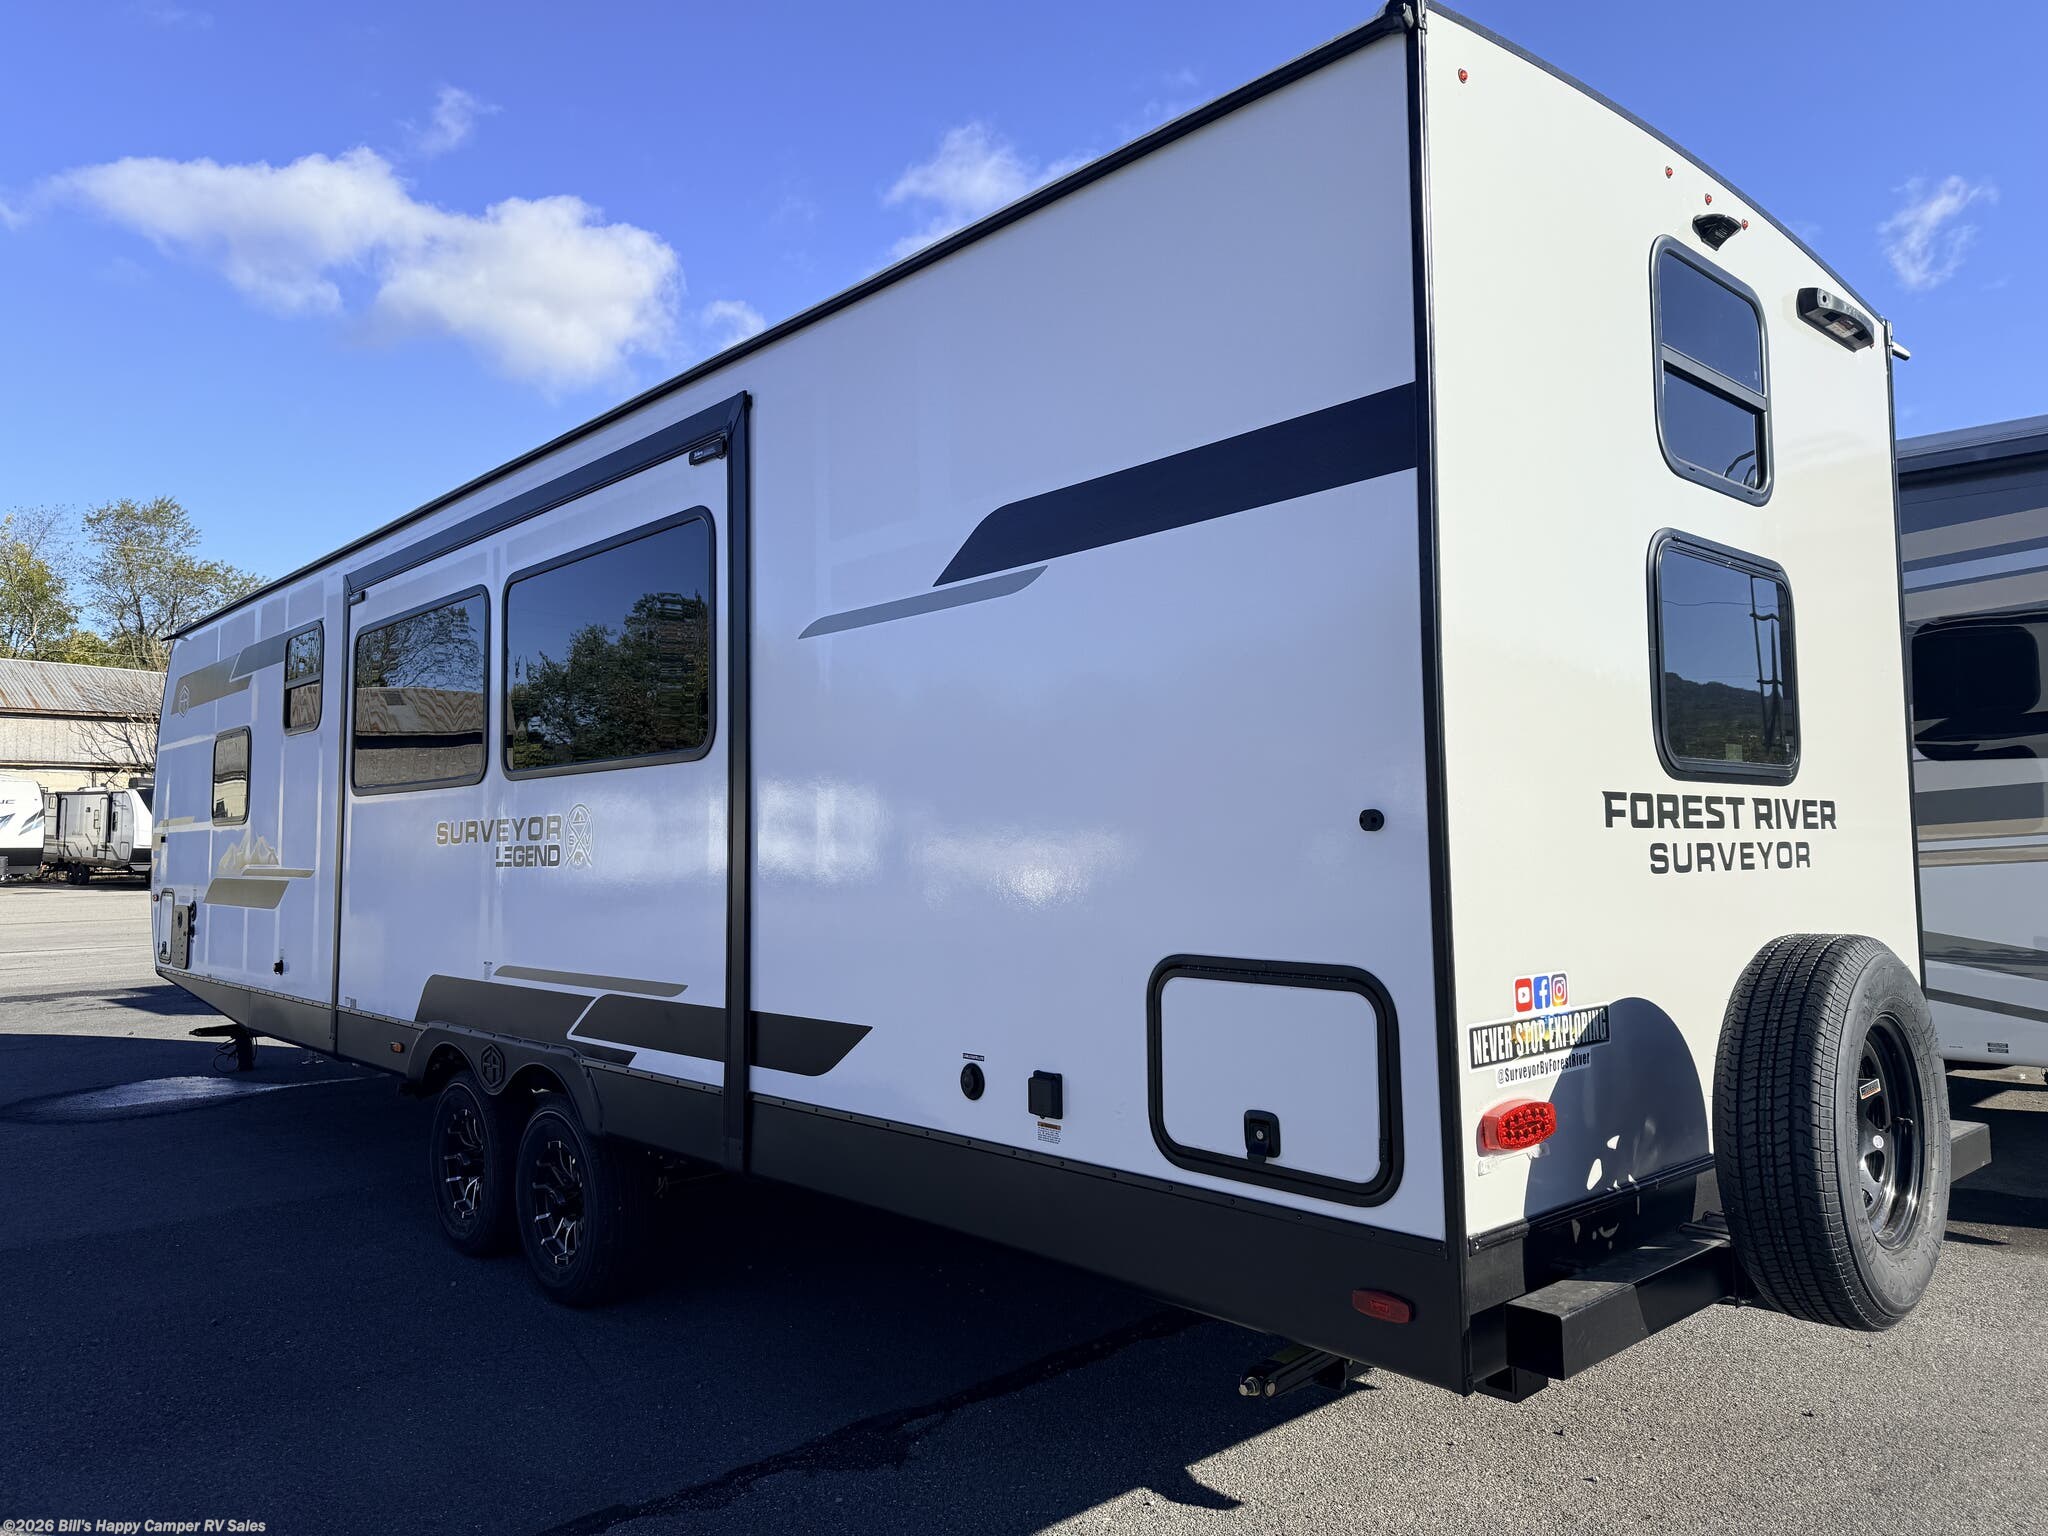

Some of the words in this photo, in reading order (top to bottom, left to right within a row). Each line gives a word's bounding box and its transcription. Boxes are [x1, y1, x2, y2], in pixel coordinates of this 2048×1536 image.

[1601, 790, 1746, 829] FOREST
[1751, 797, 1838, 830] RIVER
[436, 815, 562, 845] SURVEYOR
[495, 844, 561, 868] LEGEND
[1650, 841, 1811, 875] SURVEYOR
[1472, 1025, 1513, 1065] NEVER
[1515, 1018, 1545, 1056] STOP
[1549, 1008, 1607, 1050] EXPLORING
[1497, 1052, 1590, 1084] @SurveyorByForestRiver
